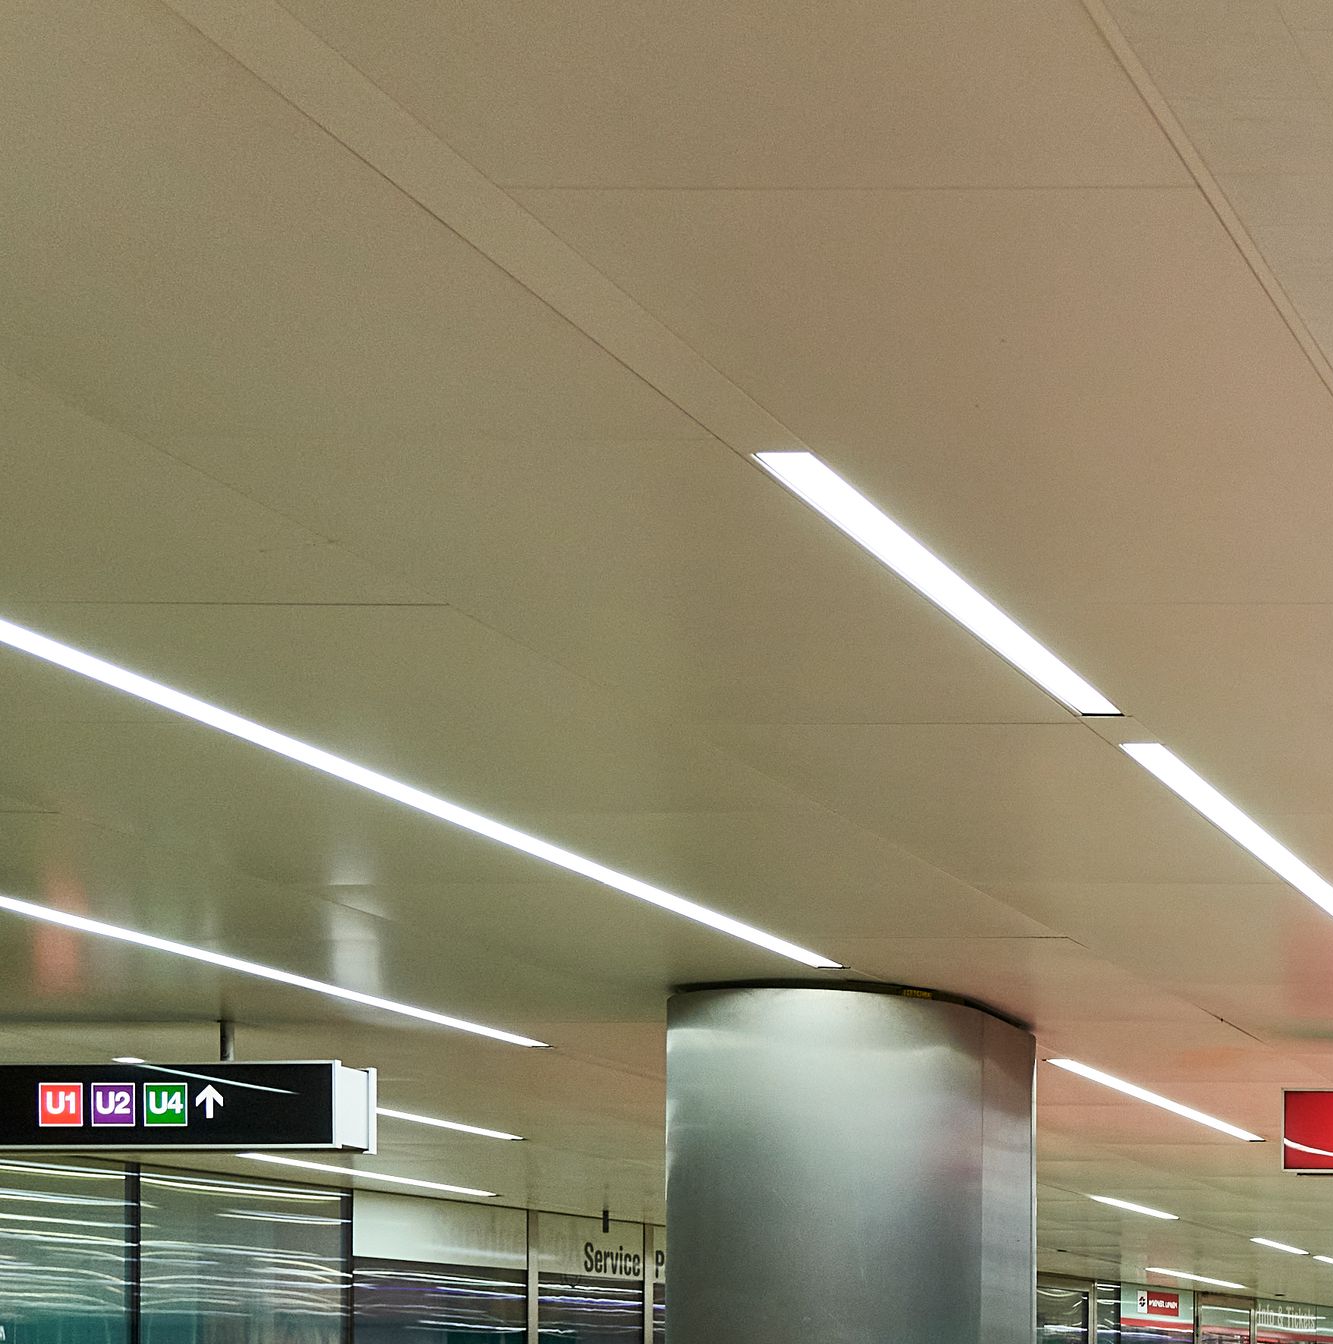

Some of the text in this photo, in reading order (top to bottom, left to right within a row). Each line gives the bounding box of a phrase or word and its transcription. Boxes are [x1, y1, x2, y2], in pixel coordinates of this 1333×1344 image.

[46, 1090, 184, 1115] U1 U2 U4
[584, 1241, 641, 1277] Service
